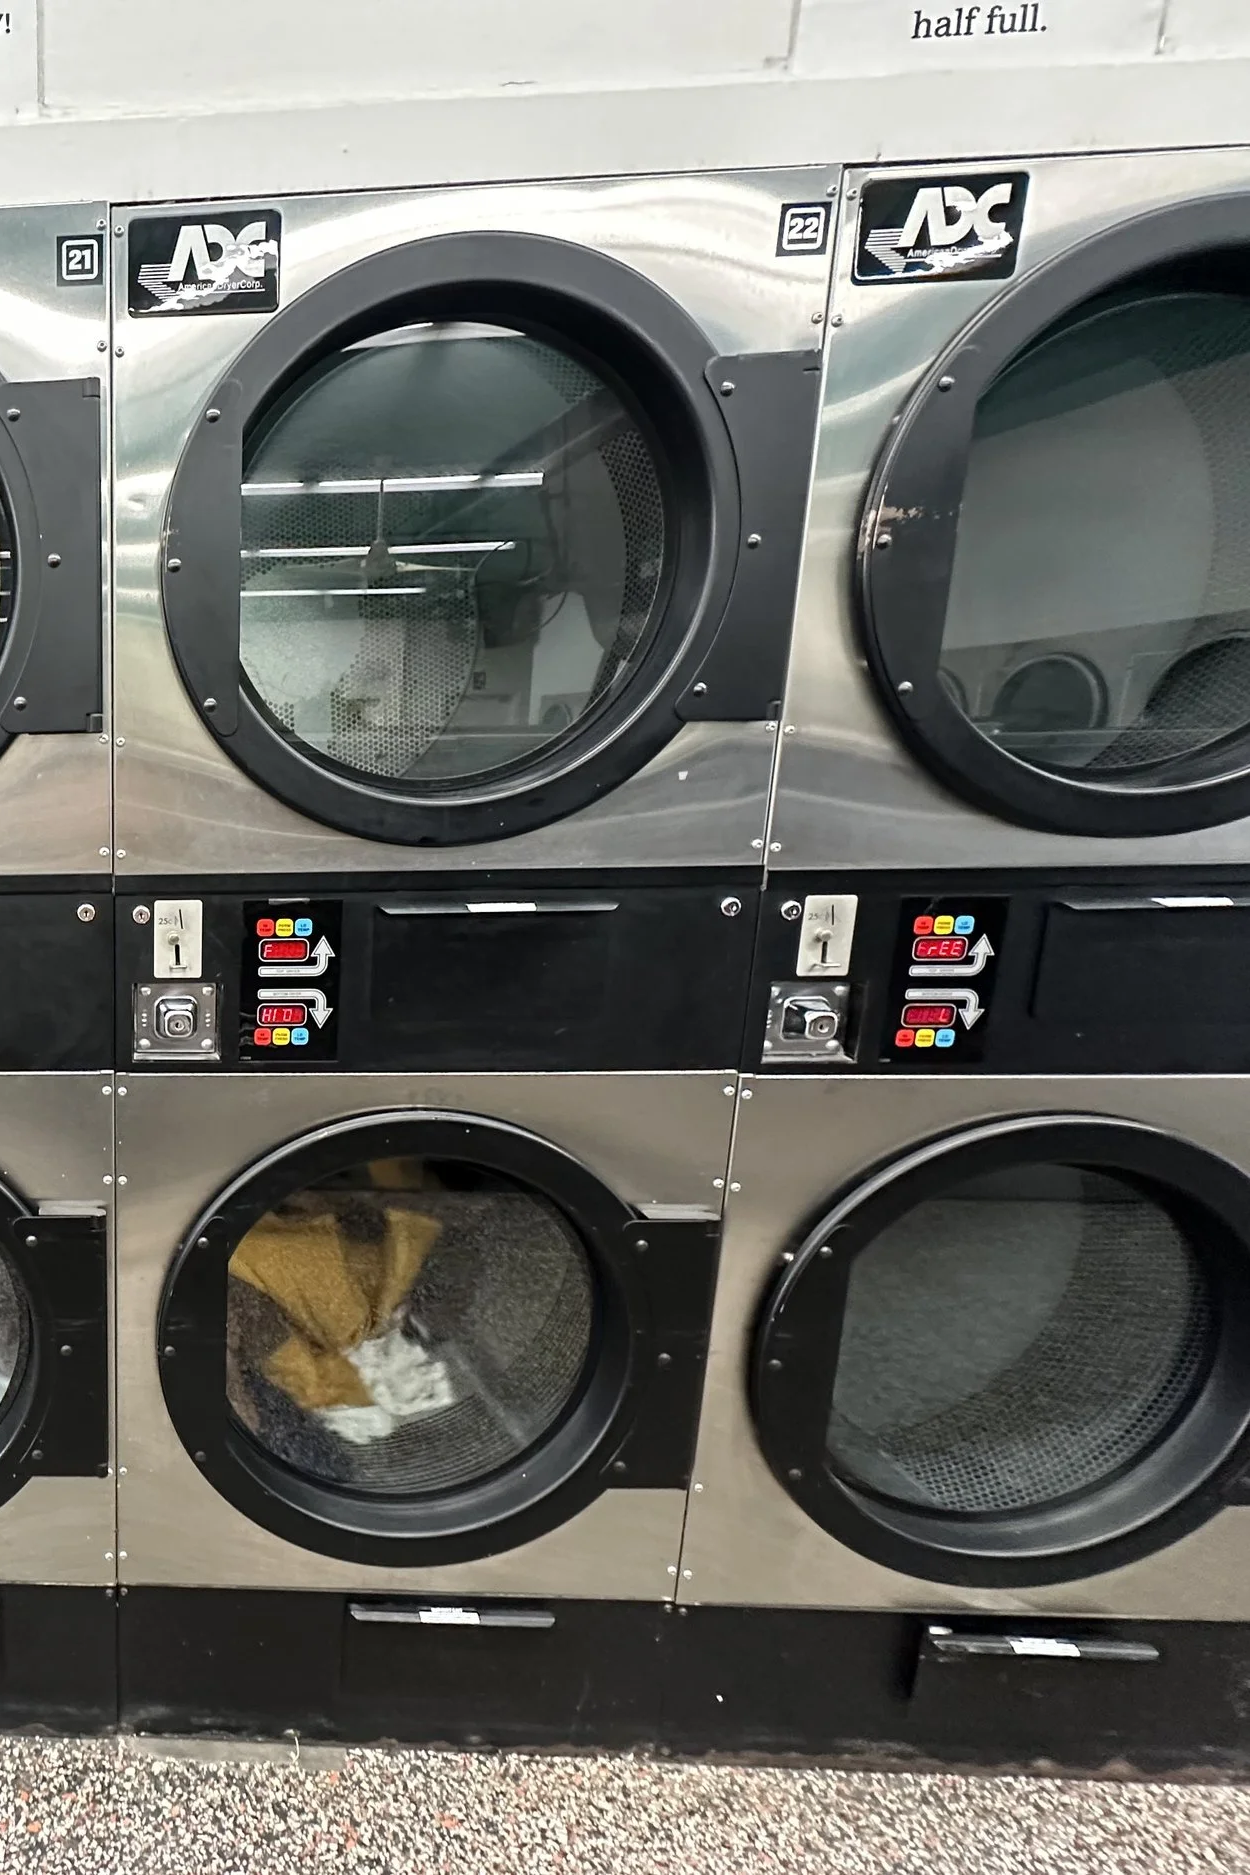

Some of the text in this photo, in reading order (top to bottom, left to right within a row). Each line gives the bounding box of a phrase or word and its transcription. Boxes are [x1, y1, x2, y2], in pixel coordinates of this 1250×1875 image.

[911, 3, 1047, 39] half full.
[788, 216, 820, 239] 22
[898, 182, 1013, 247] ADC
[68, 249, 92, 270] 21
[167, 221, 267, 282] ADC
